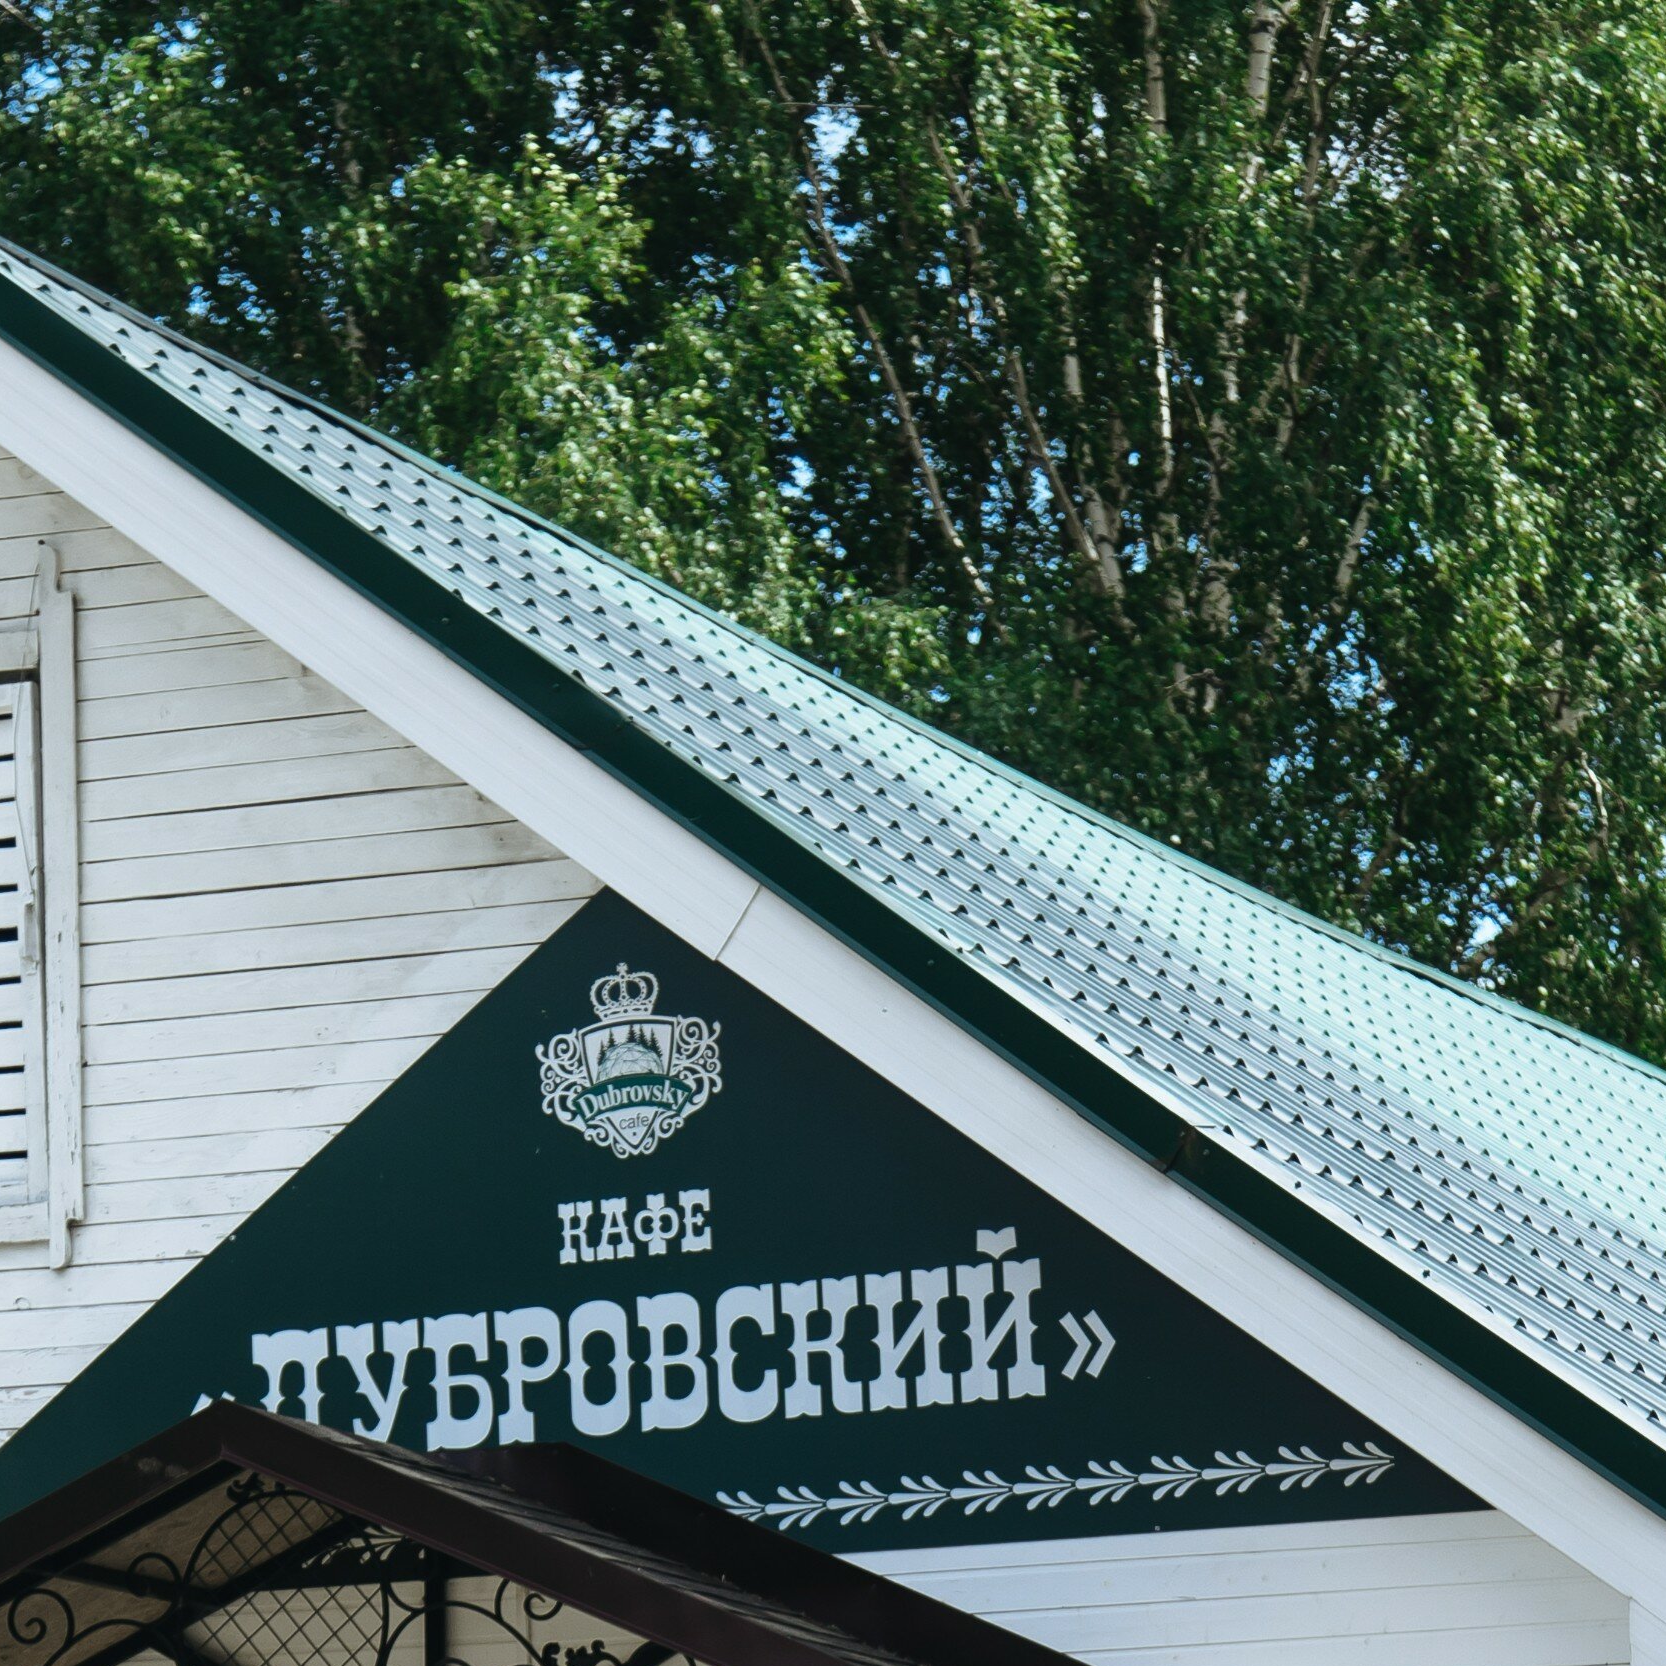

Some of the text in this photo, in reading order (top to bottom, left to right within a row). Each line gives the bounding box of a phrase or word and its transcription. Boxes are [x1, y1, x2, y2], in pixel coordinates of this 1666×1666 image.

[576, 1079, 690, 1120] Dubrovsky
[618, 1112, 650, 1131] cafe
[557, 1188, 712, 1265] КАФЕ
